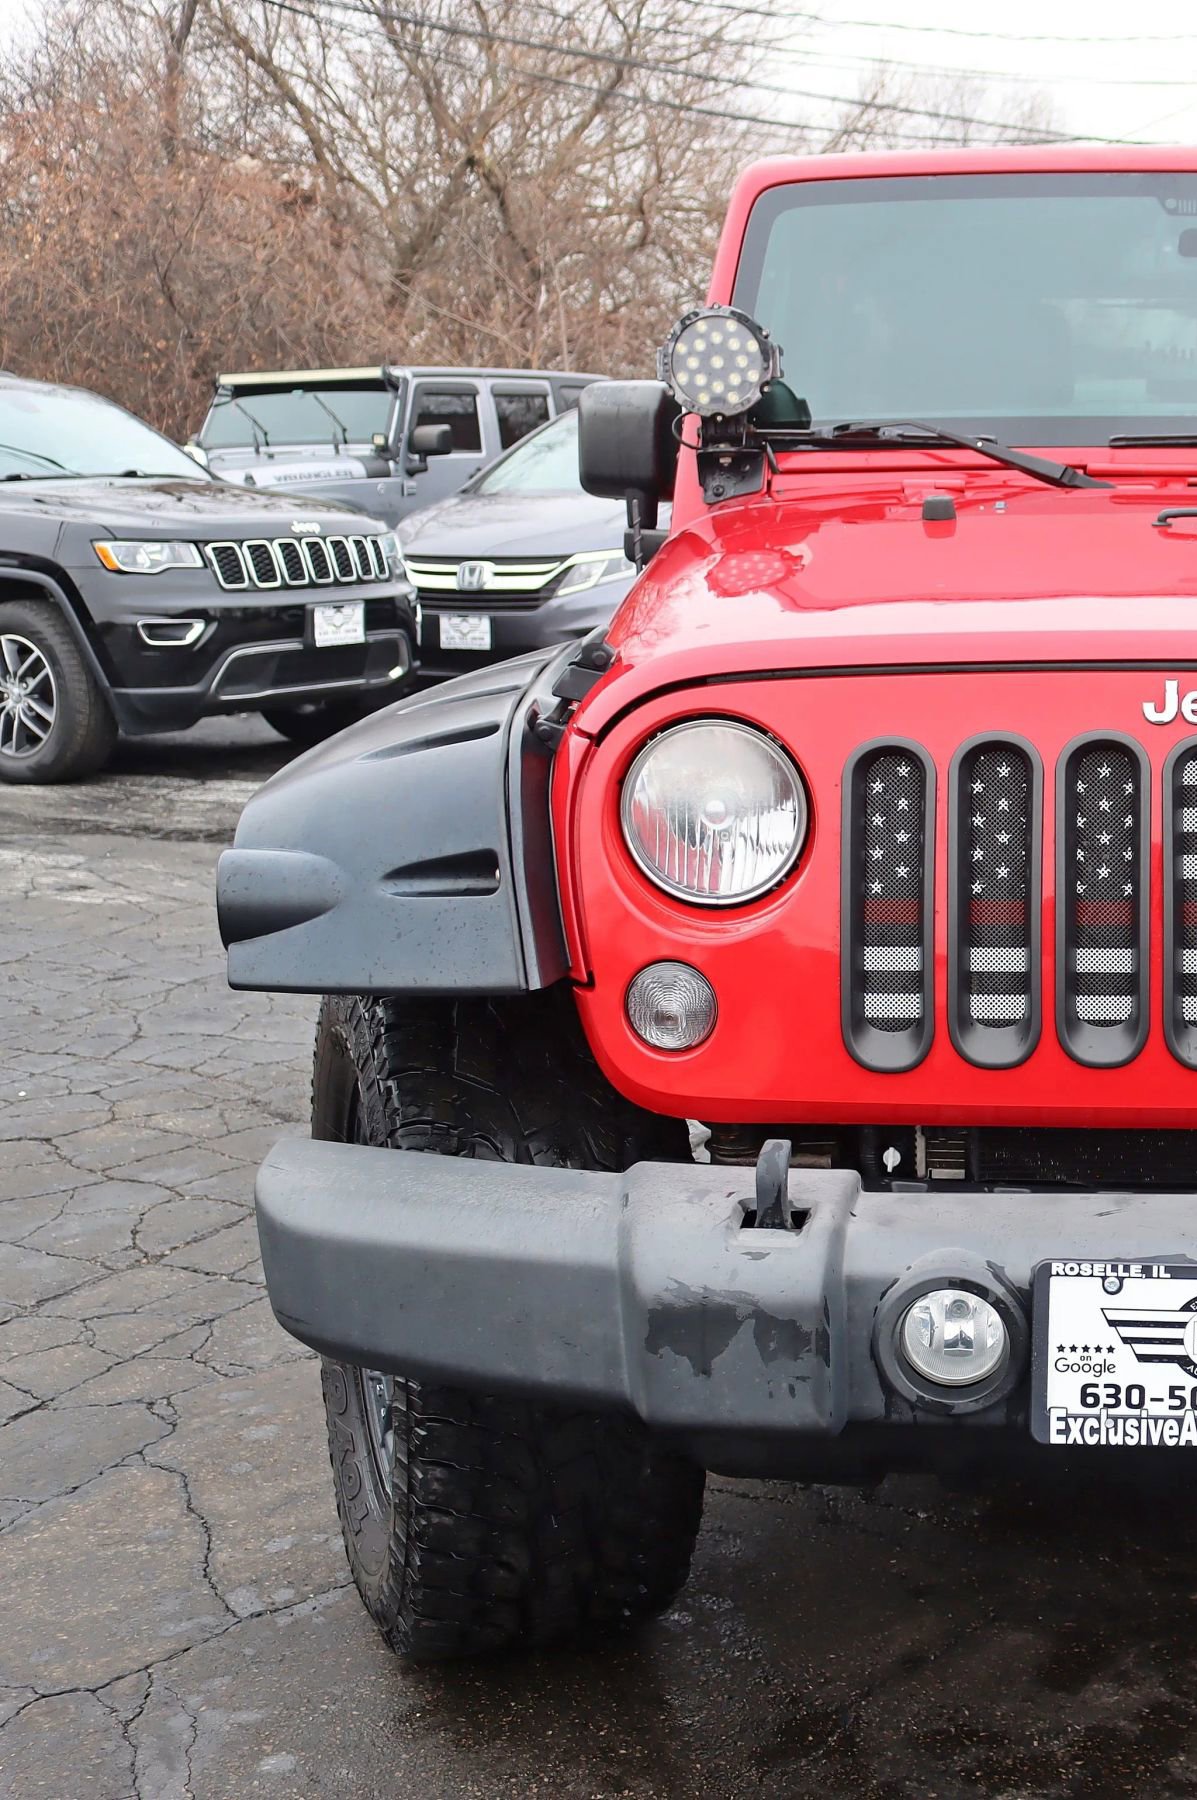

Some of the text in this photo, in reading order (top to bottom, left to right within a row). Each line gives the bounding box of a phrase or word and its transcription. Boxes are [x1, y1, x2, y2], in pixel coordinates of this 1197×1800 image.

[1051, 1262, 1171, 1279] ROSELLE, IL
[1054, 1357, 1116, 1377] Google
